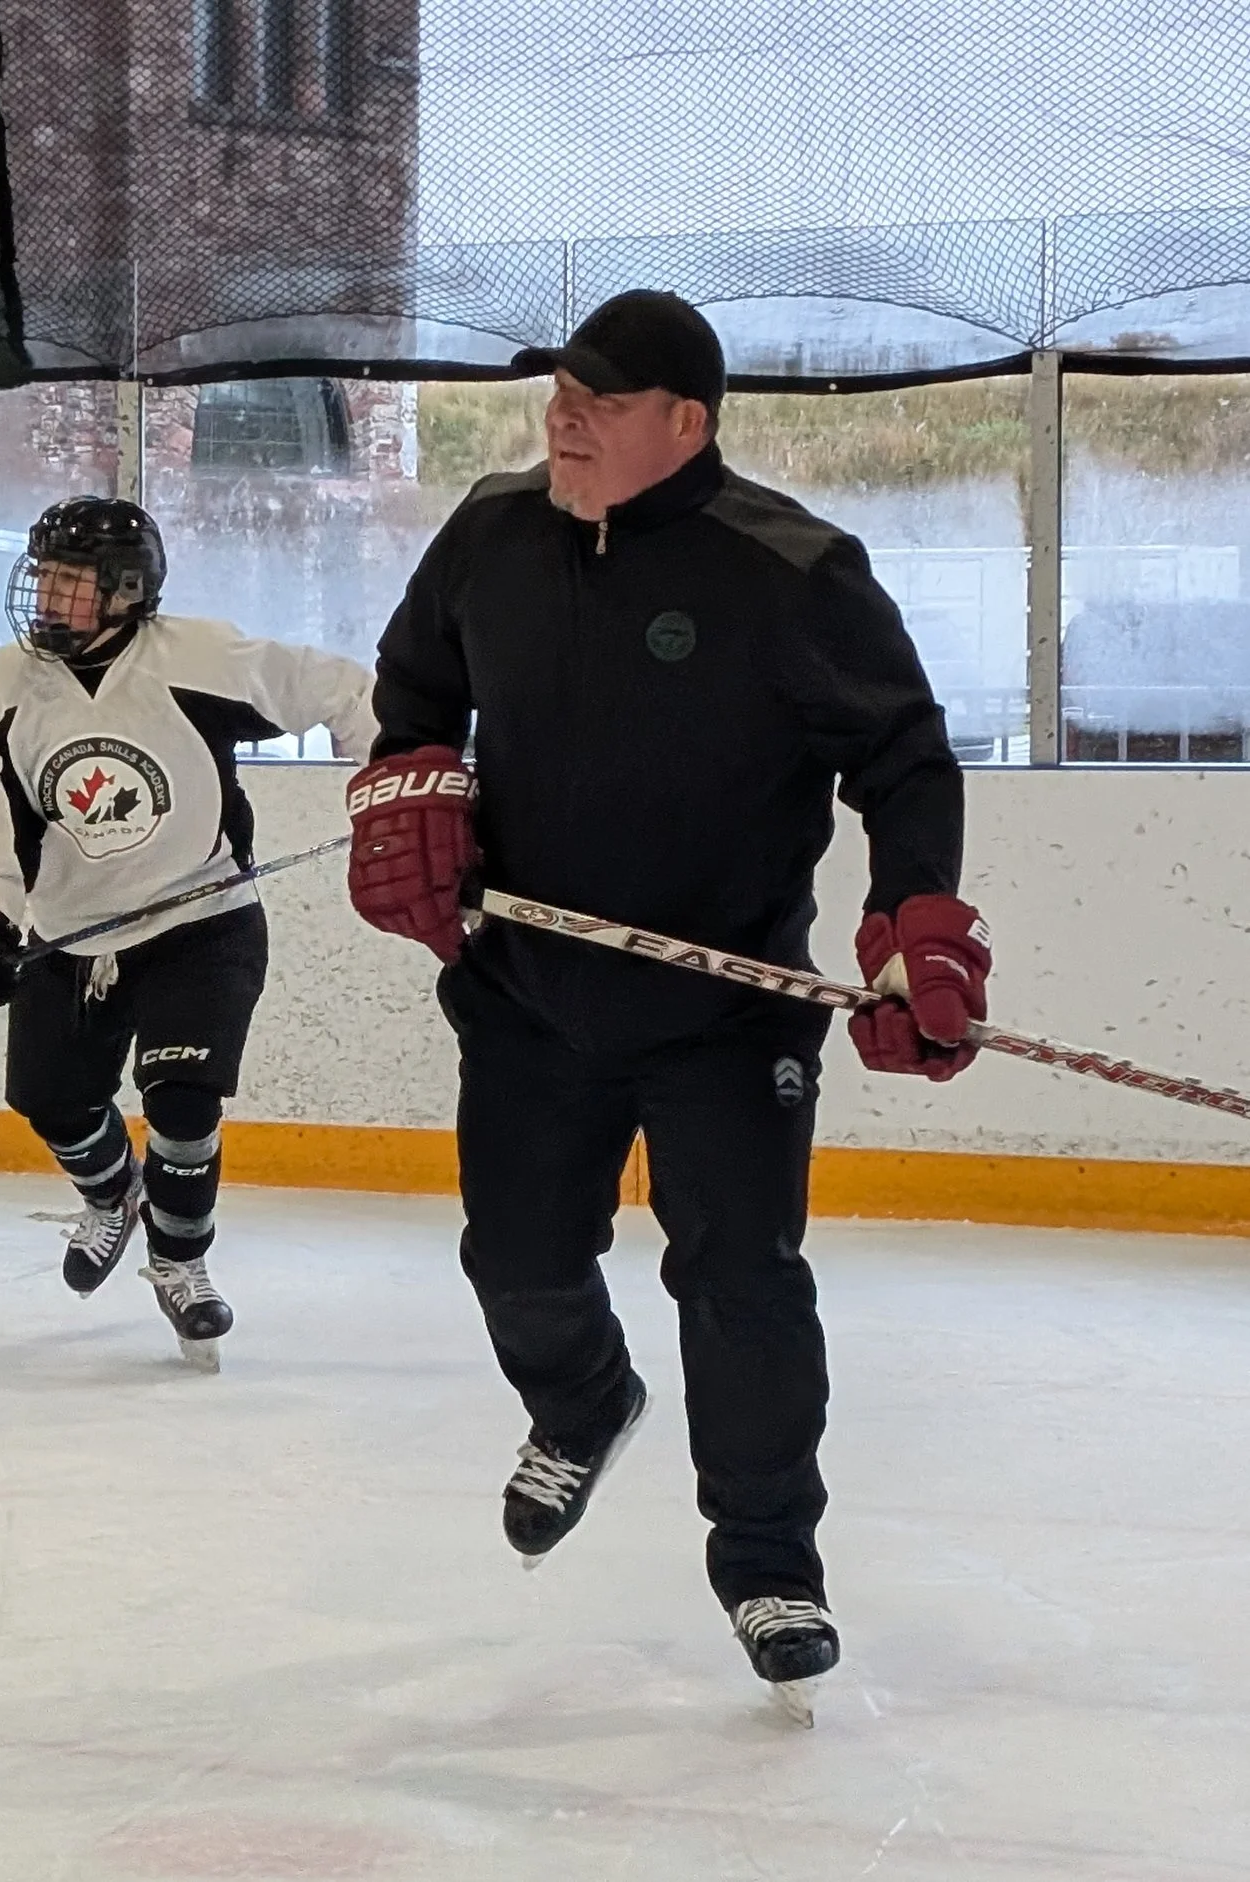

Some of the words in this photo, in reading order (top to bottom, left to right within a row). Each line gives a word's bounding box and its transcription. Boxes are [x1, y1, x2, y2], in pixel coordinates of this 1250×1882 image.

[52, 742, 96, 770] CANADA
[100, 741, 139, 763] SKILLS
[139, 759, 167, 807] ACADEMY
[74, 826, 146, 841] CANADA
[623, 929, 881, 1010] EASTO
[141, 1046, 211, 1066] CCM
[982, 1035, 1250, 1119] SYNERG
[162, 1164, 210, 1177] CCM
